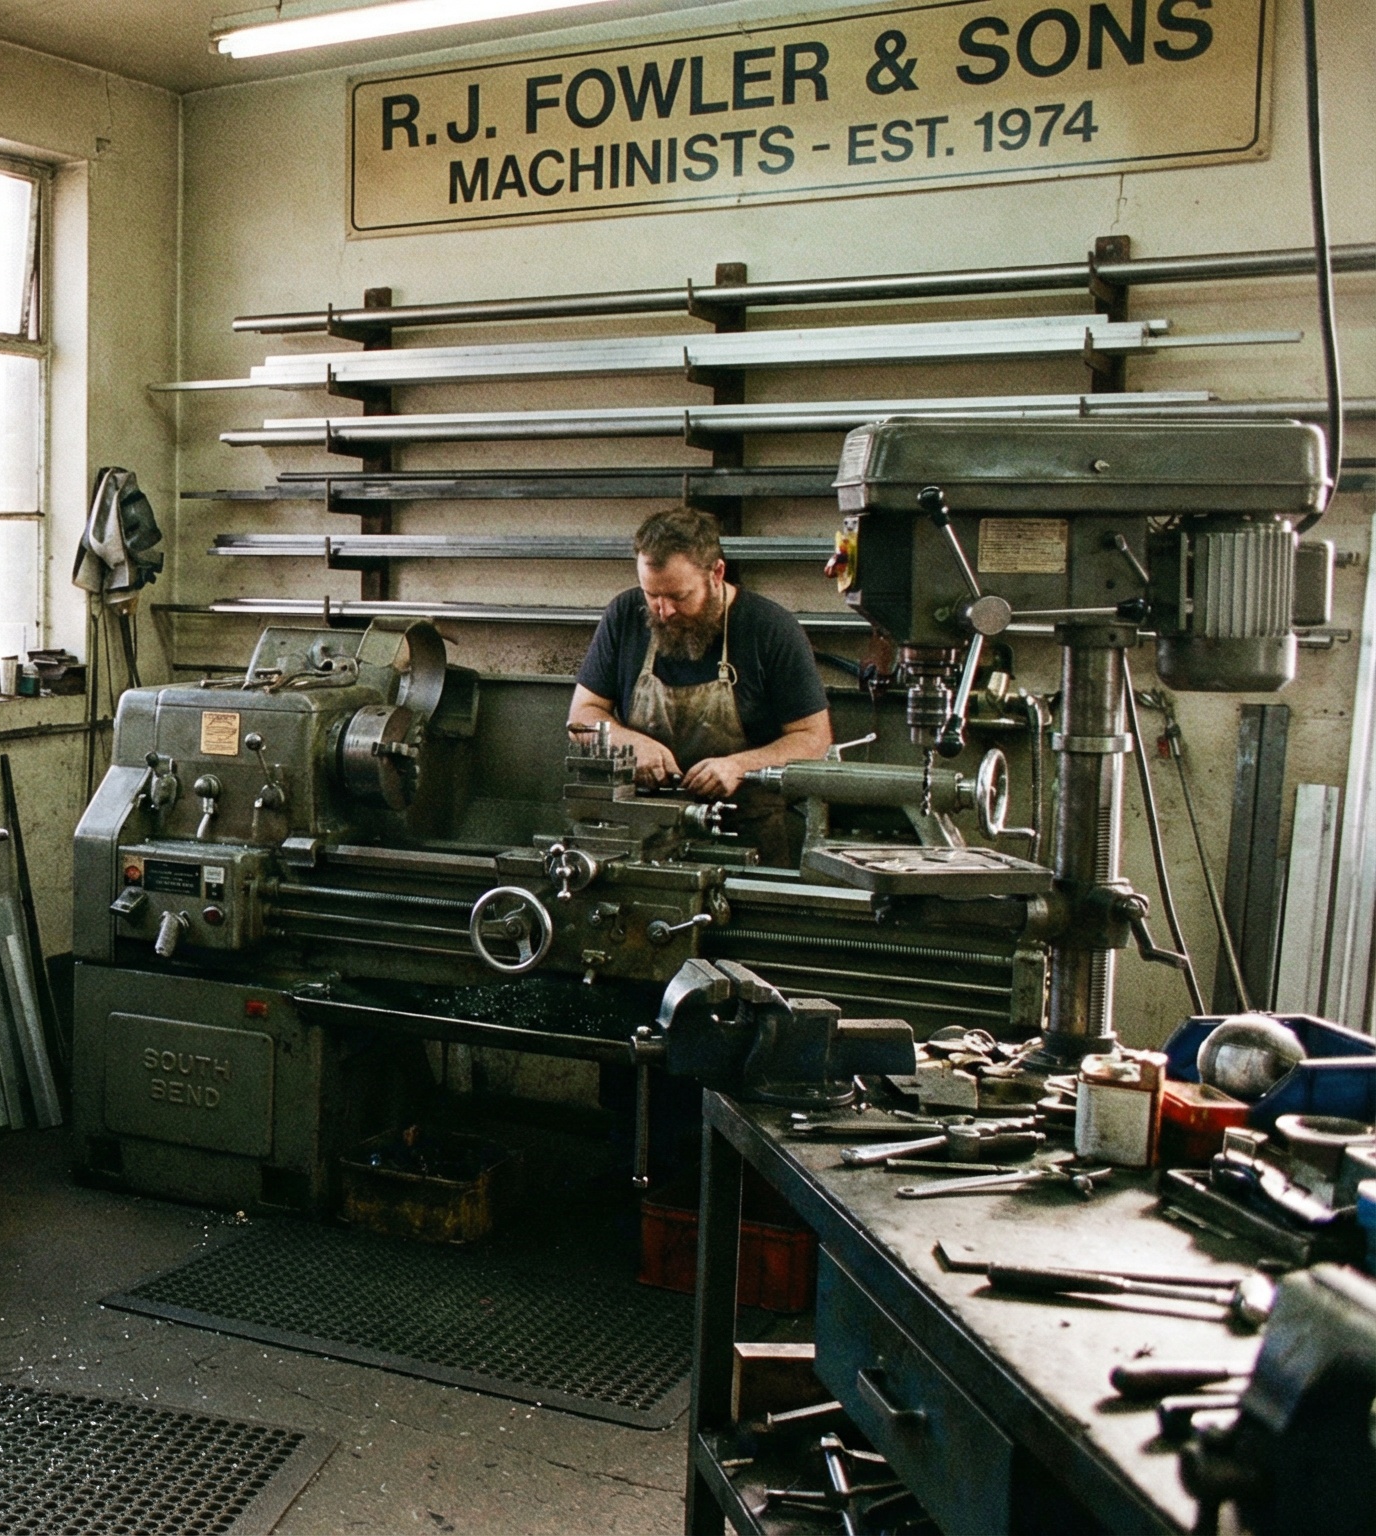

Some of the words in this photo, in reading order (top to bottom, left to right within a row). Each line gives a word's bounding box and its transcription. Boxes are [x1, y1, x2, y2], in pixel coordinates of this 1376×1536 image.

[525, 41, 830, 134] FOWLER
[865, 29, 920, 96] &
[955, 0, 1214, 85] SONS
[448, 125, 795, 204] MACHINISTS
[847, 115, 954, 166] EST.
[974, 100, 1099, 153] 1974
[143, 1047, 232, 1081] SOUTH
[150, 1078, 220, 1107] BEND
